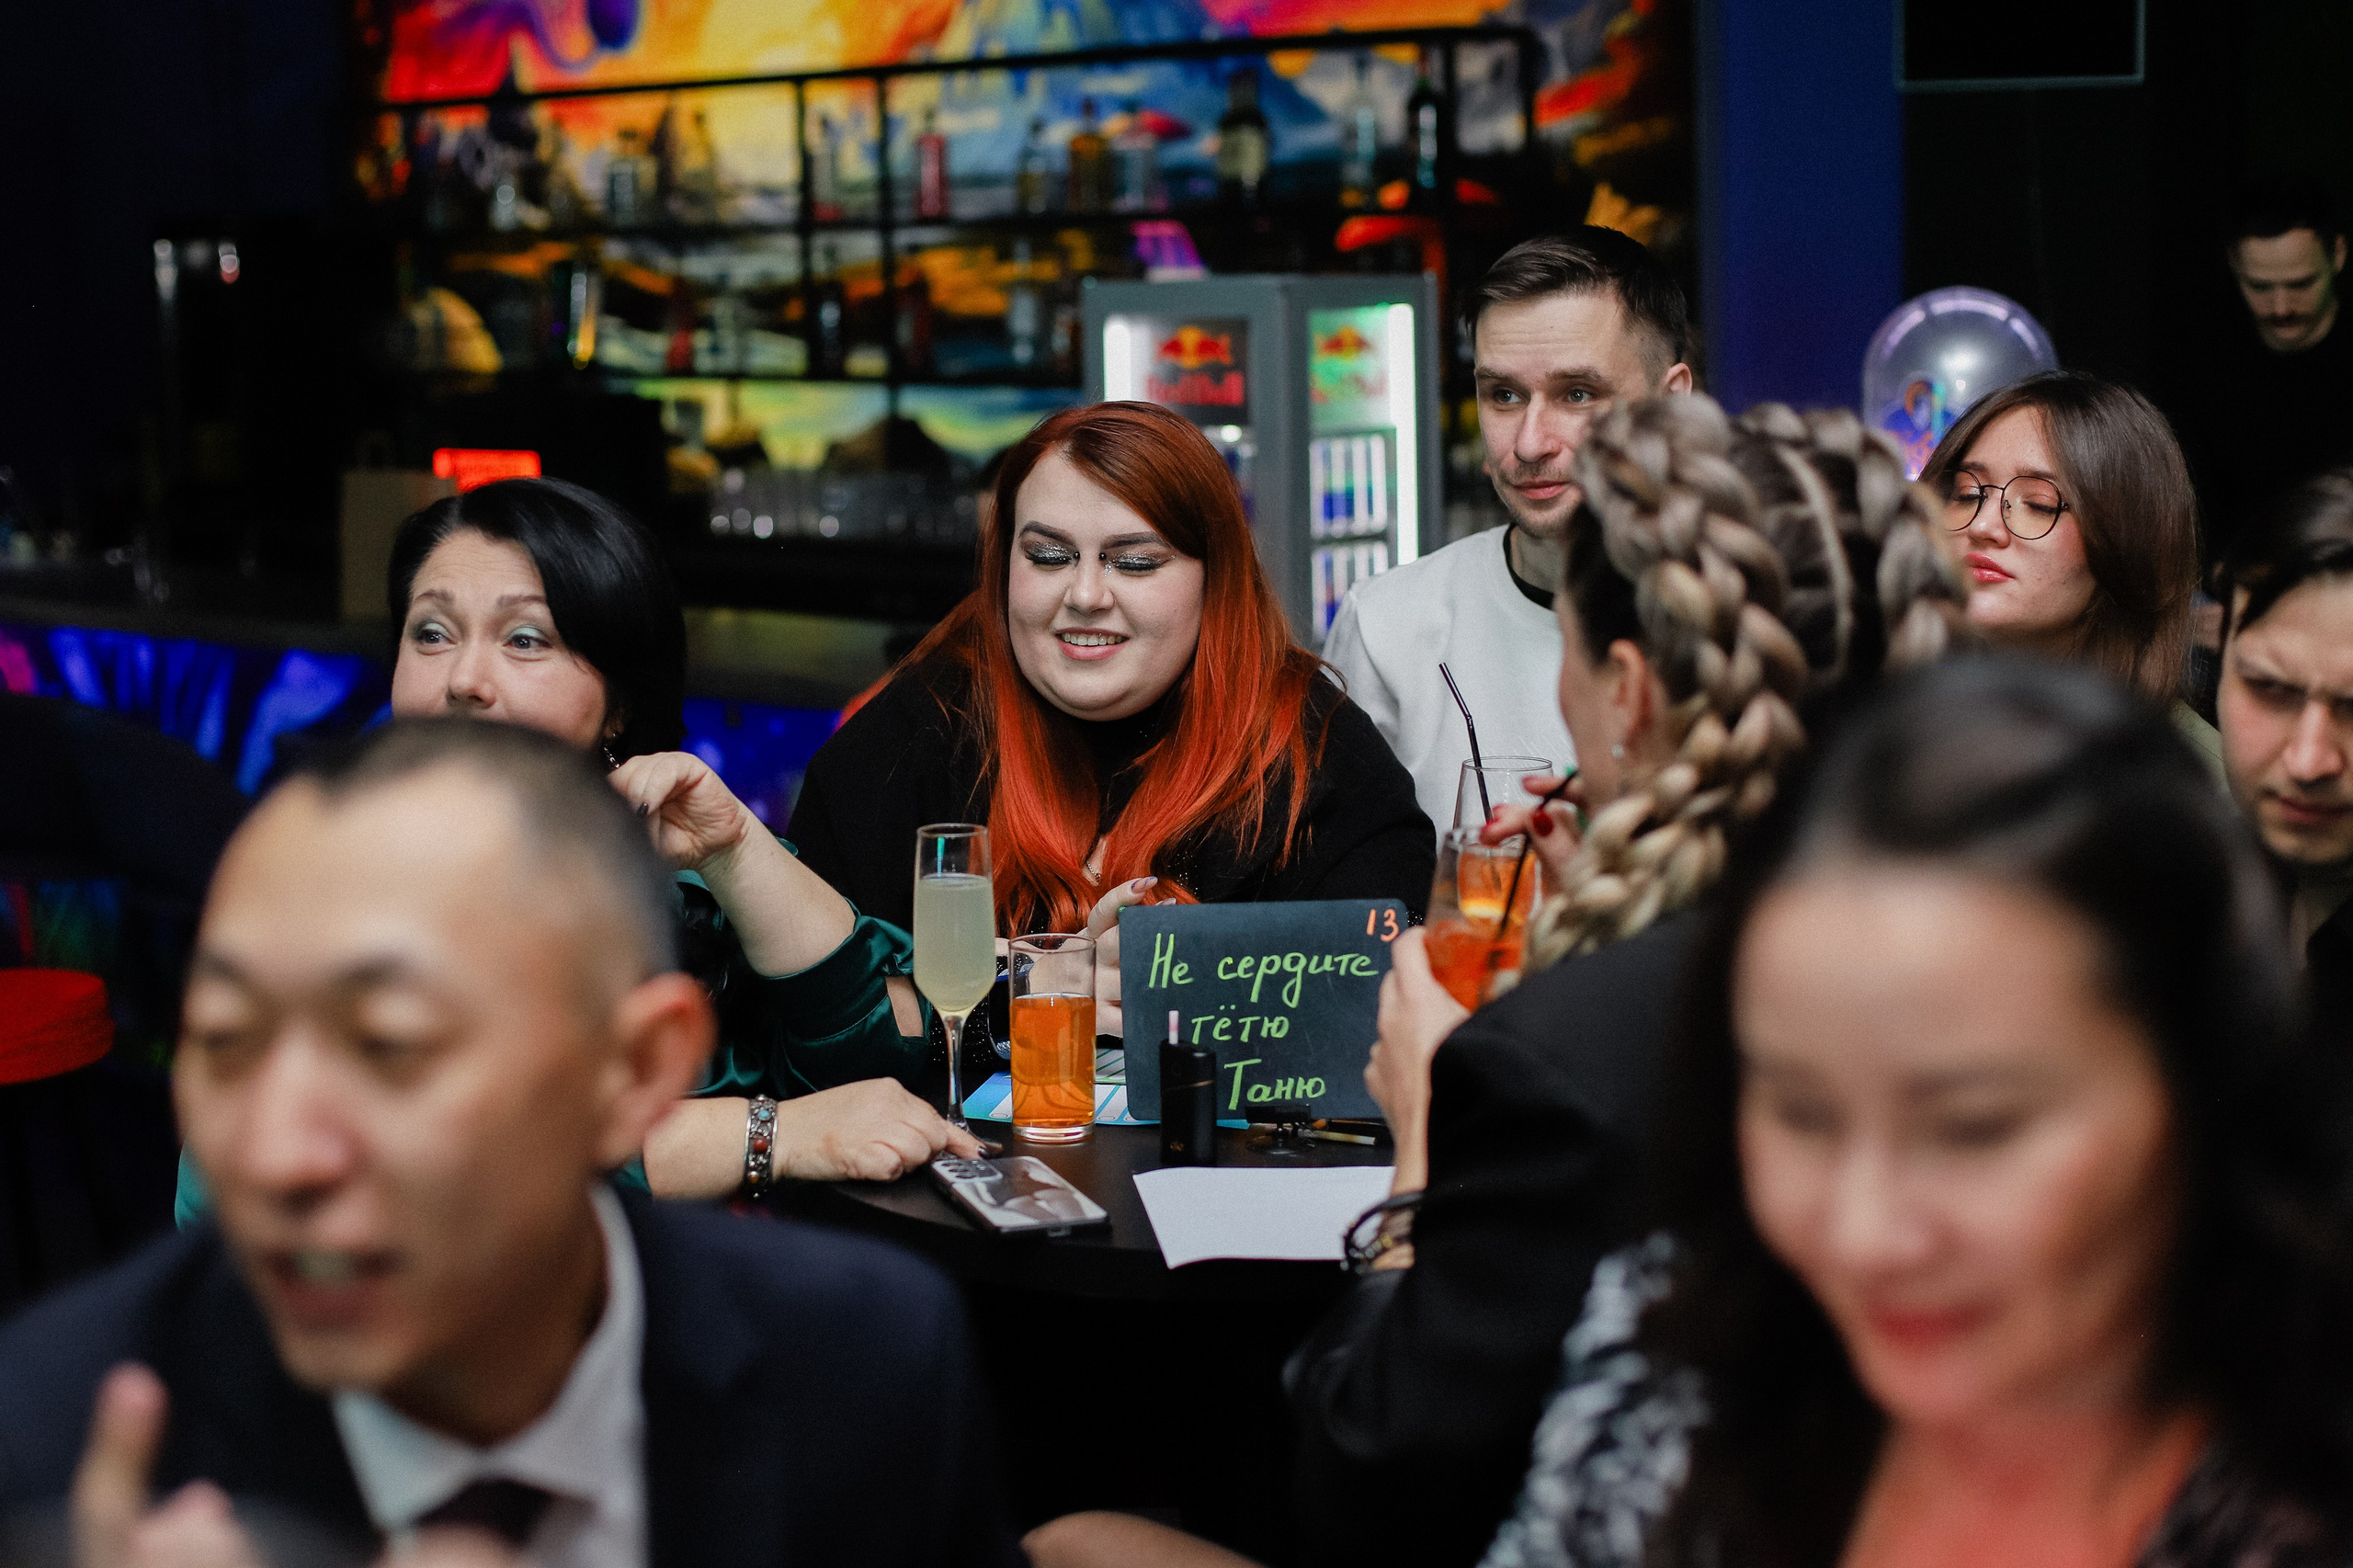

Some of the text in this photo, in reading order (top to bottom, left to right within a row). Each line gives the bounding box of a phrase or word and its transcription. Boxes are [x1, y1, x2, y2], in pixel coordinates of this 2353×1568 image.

[1366, 908, 1400, 942] 13
[1148, 932, 1379, 1009] Не сердите
[1191, 1004, 1290, 1045] тётю
[1223, 1058, 1326, 1110] Таню
